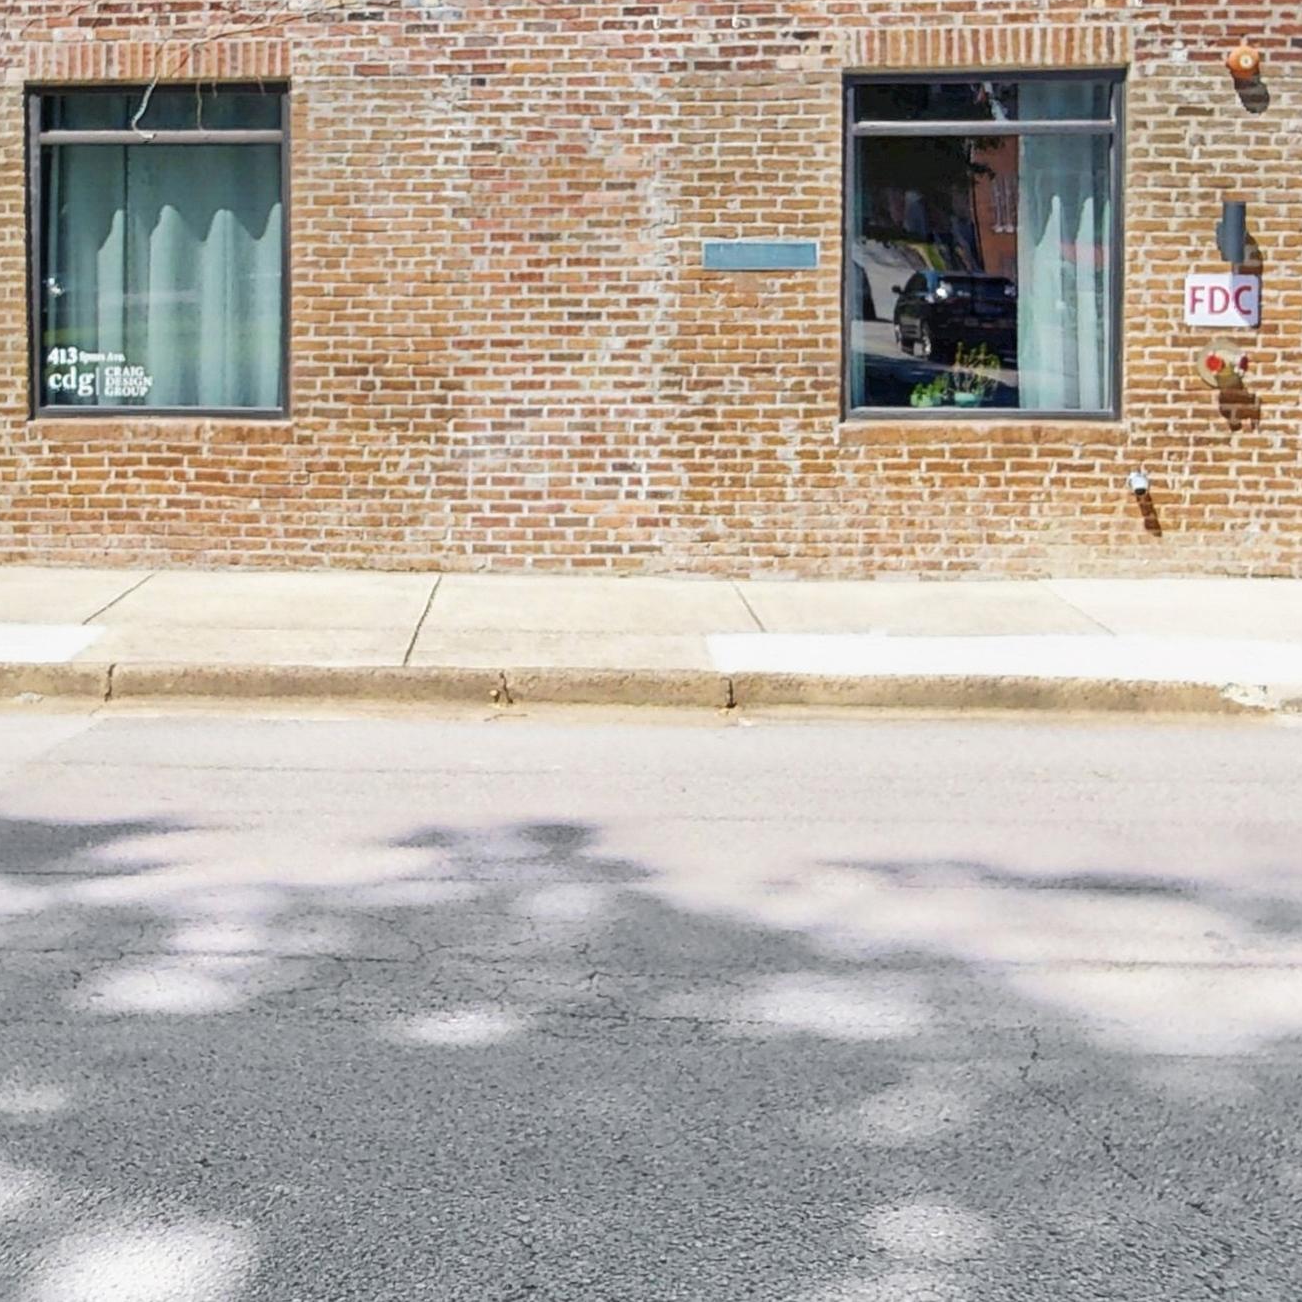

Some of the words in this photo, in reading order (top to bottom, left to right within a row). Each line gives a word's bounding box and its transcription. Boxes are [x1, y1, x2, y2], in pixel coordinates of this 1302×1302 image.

[1189, 284, 1253, 315] FDC
[47, 346, 78, 365] 413
[104, 366, 144, 376] CRAIG
[48, 365, 95, 396] cdg
[105, 376, 154, 386] DESIGN
[104, 386, 149, 396] GROUP
